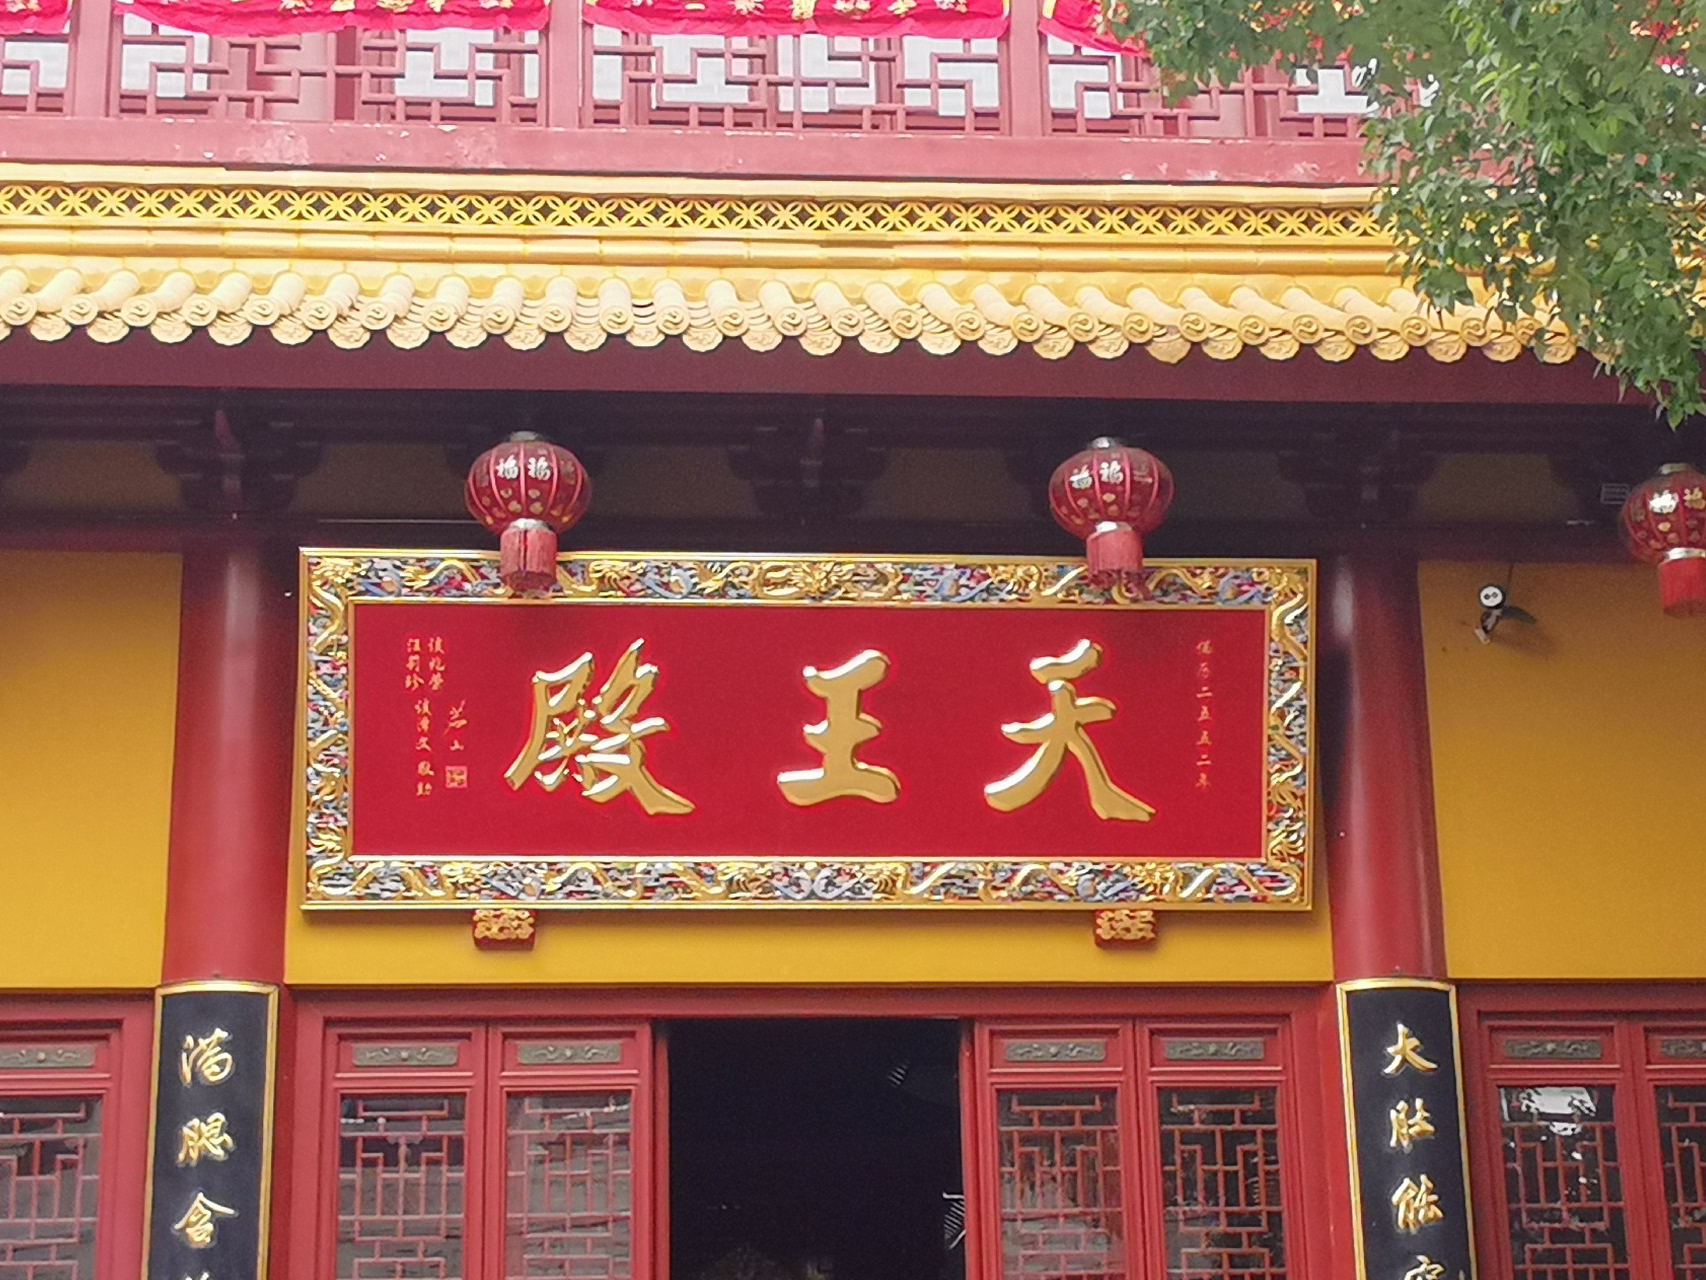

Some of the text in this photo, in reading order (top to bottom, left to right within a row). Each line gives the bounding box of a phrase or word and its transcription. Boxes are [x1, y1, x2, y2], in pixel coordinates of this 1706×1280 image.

[1099, 461, 1124, 485] 福
[505, 636, 1157, 822] 天王殿
